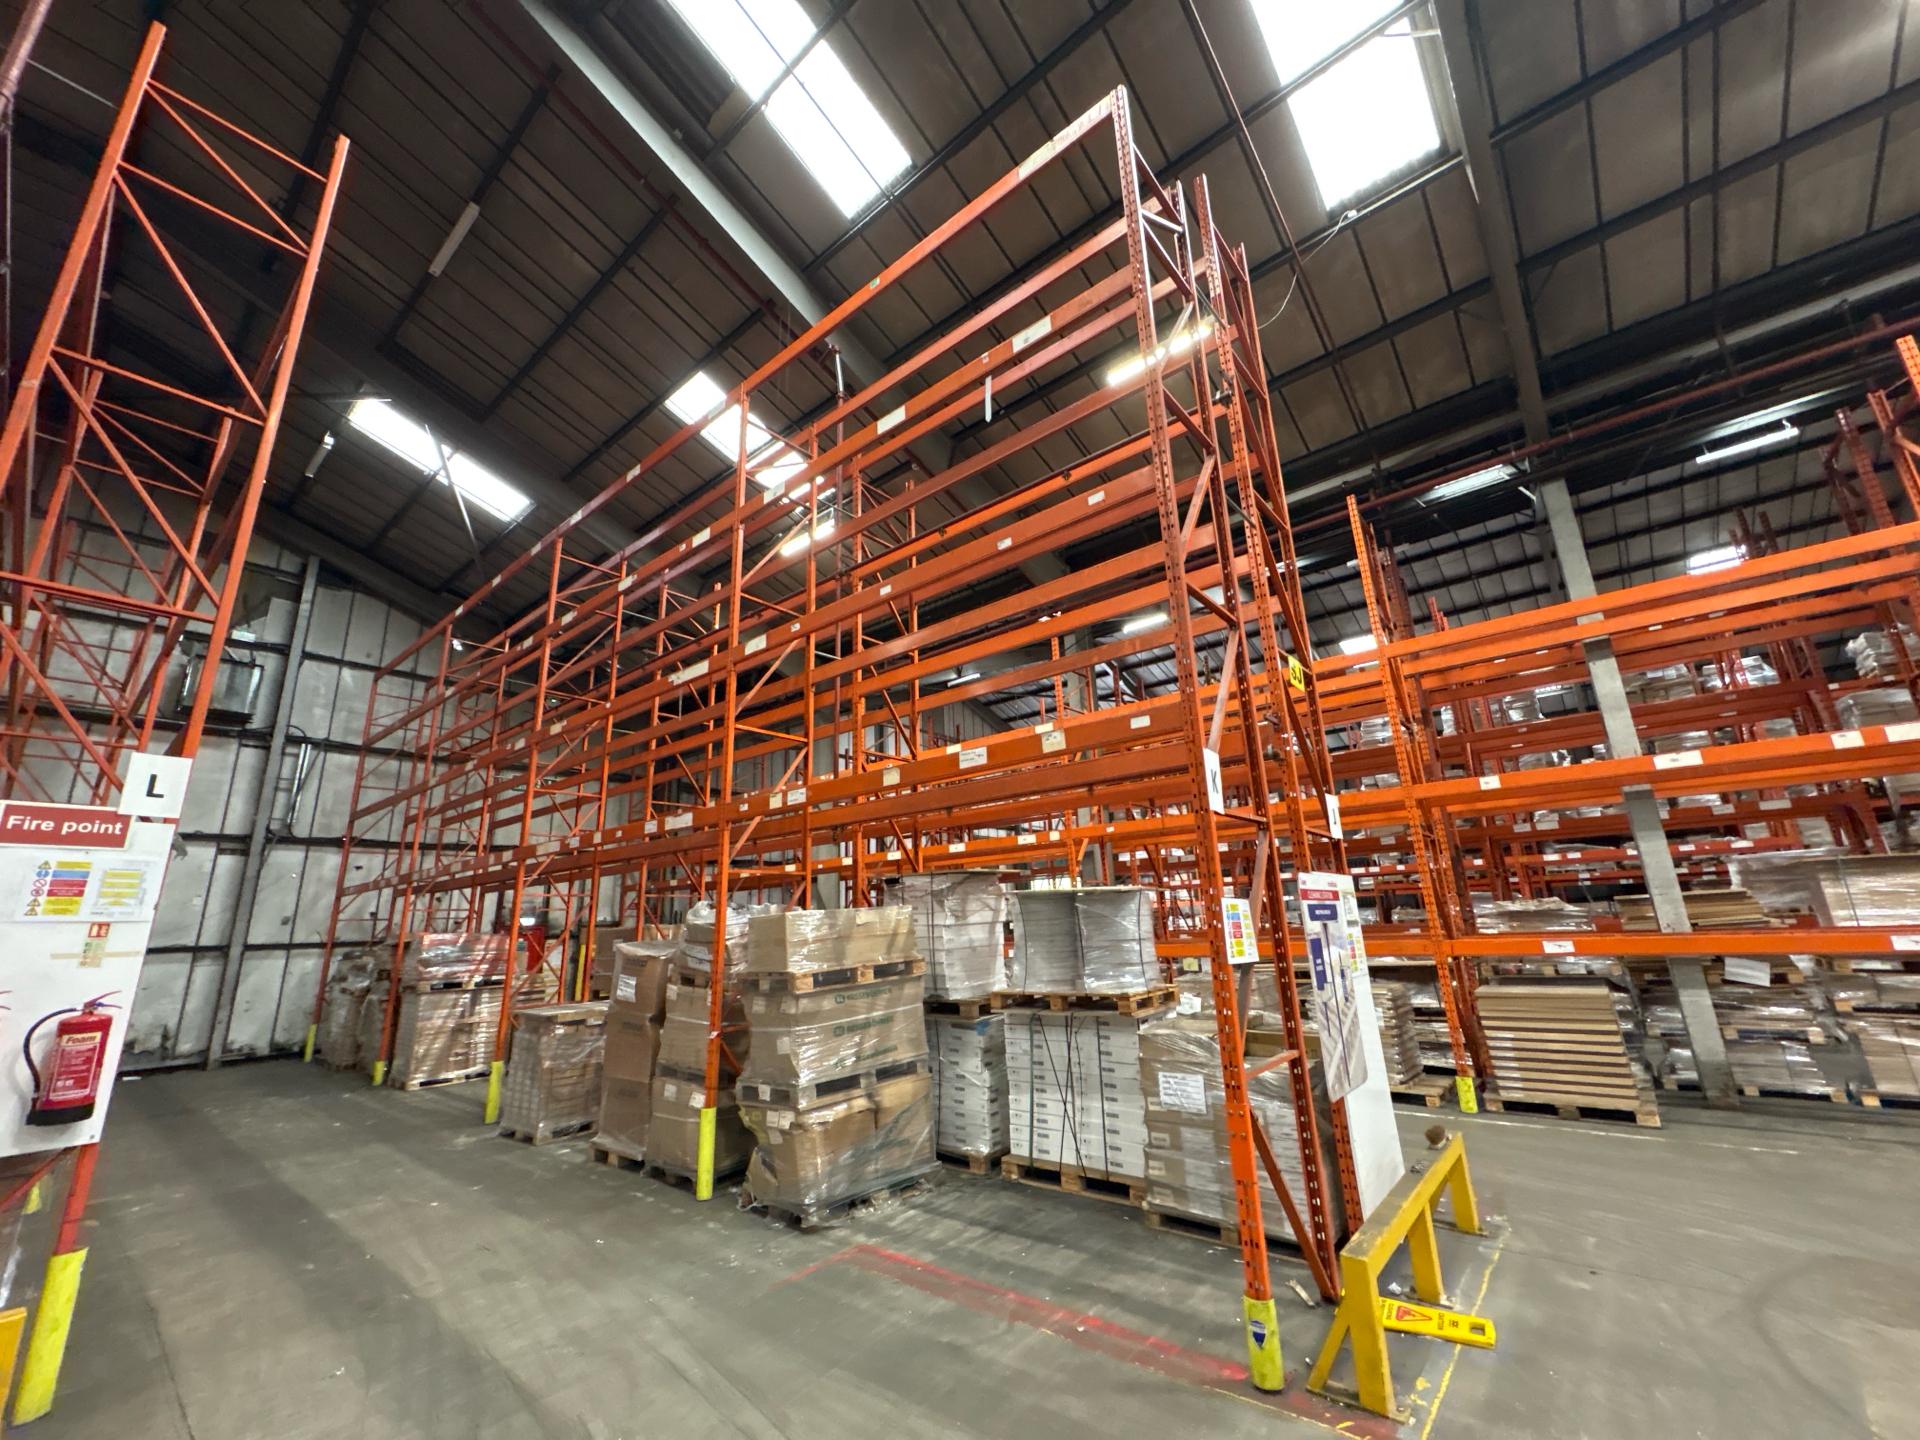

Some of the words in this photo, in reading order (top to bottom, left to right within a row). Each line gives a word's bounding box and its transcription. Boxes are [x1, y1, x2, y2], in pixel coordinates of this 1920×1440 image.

[146, 774, 164, 798] L
[1211, 769, 1219, 794] K
[6, 815, 54, 832] Fire
[61, 820, 124, 836] point
